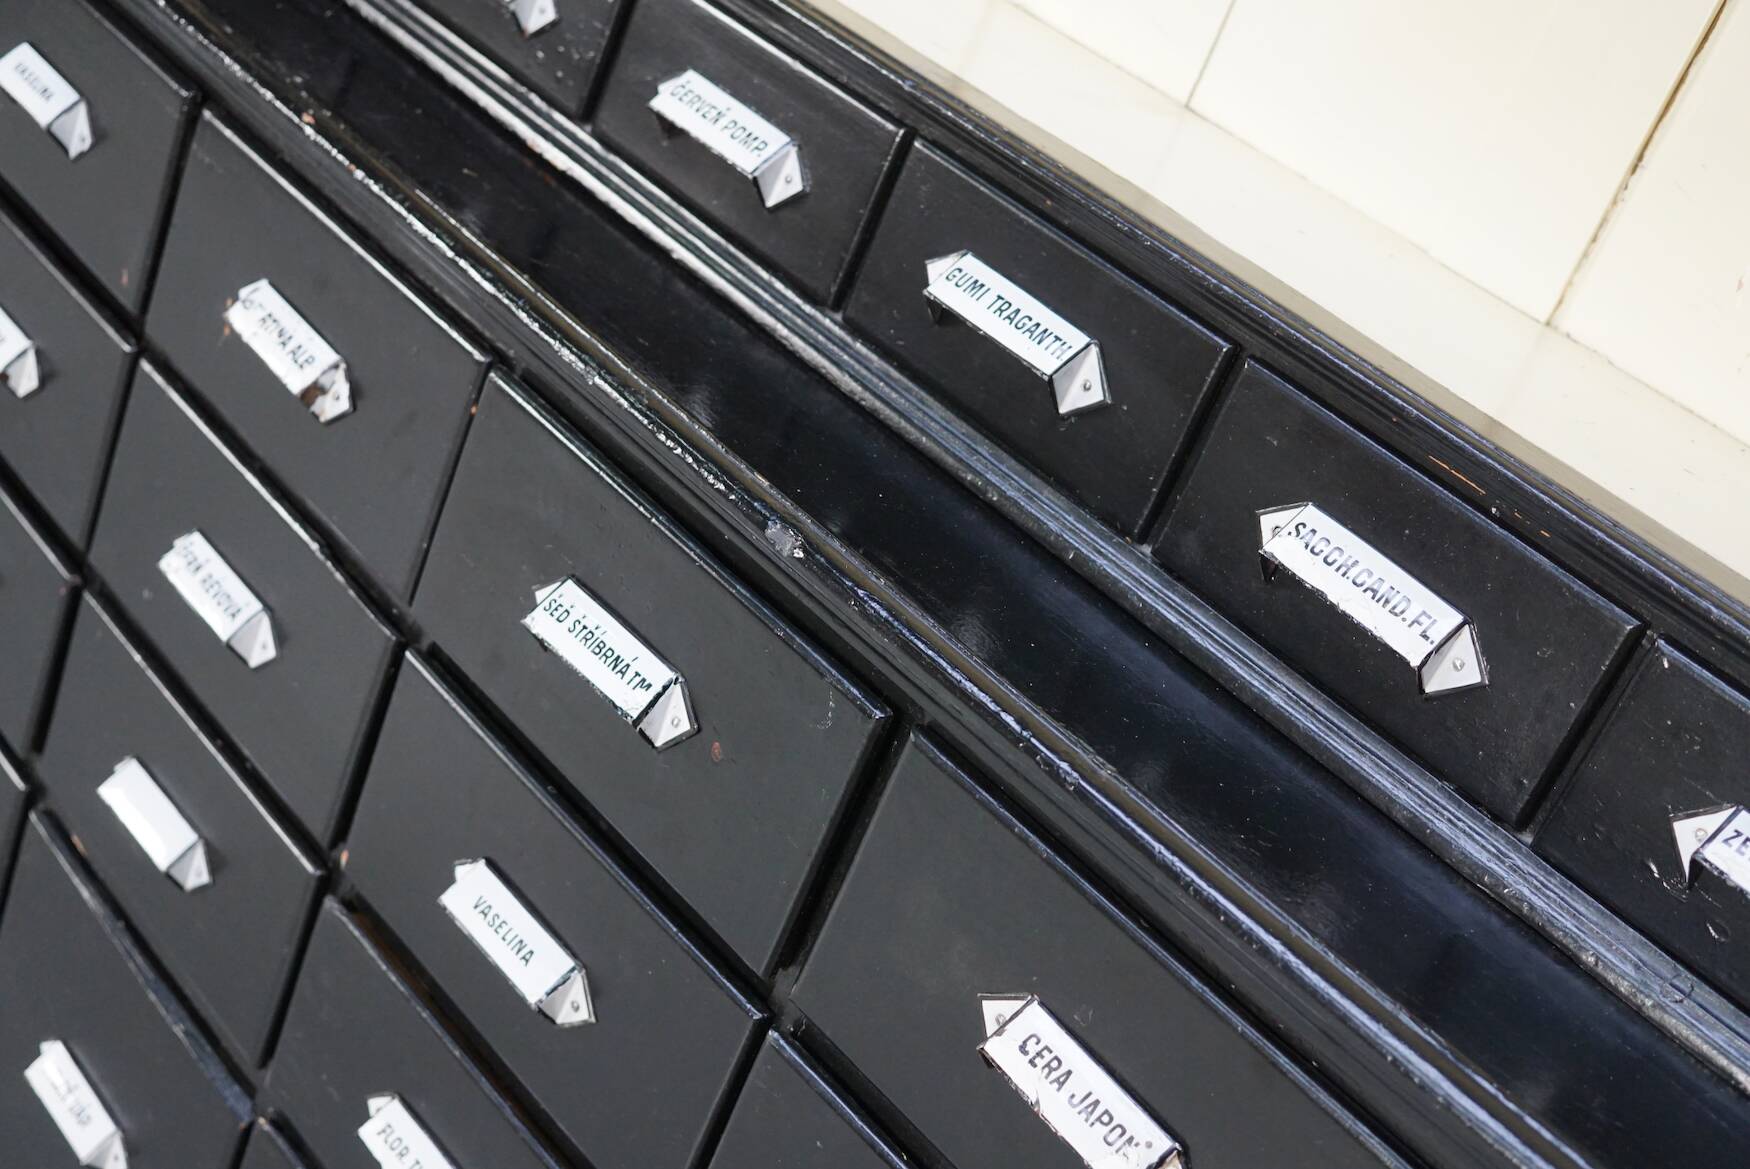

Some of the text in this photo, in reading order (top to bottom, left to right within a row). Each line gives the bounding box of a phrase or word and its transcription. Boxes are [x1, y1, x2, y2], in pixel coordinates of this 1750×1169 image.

[945, 267, 1073, 361] GUMI TRAGANTH.
[1722, 829, 1750, 861] ZE
[473, 895, 535, 967] VASELINA
[1018, 1033, 1073, 1092] CERA
